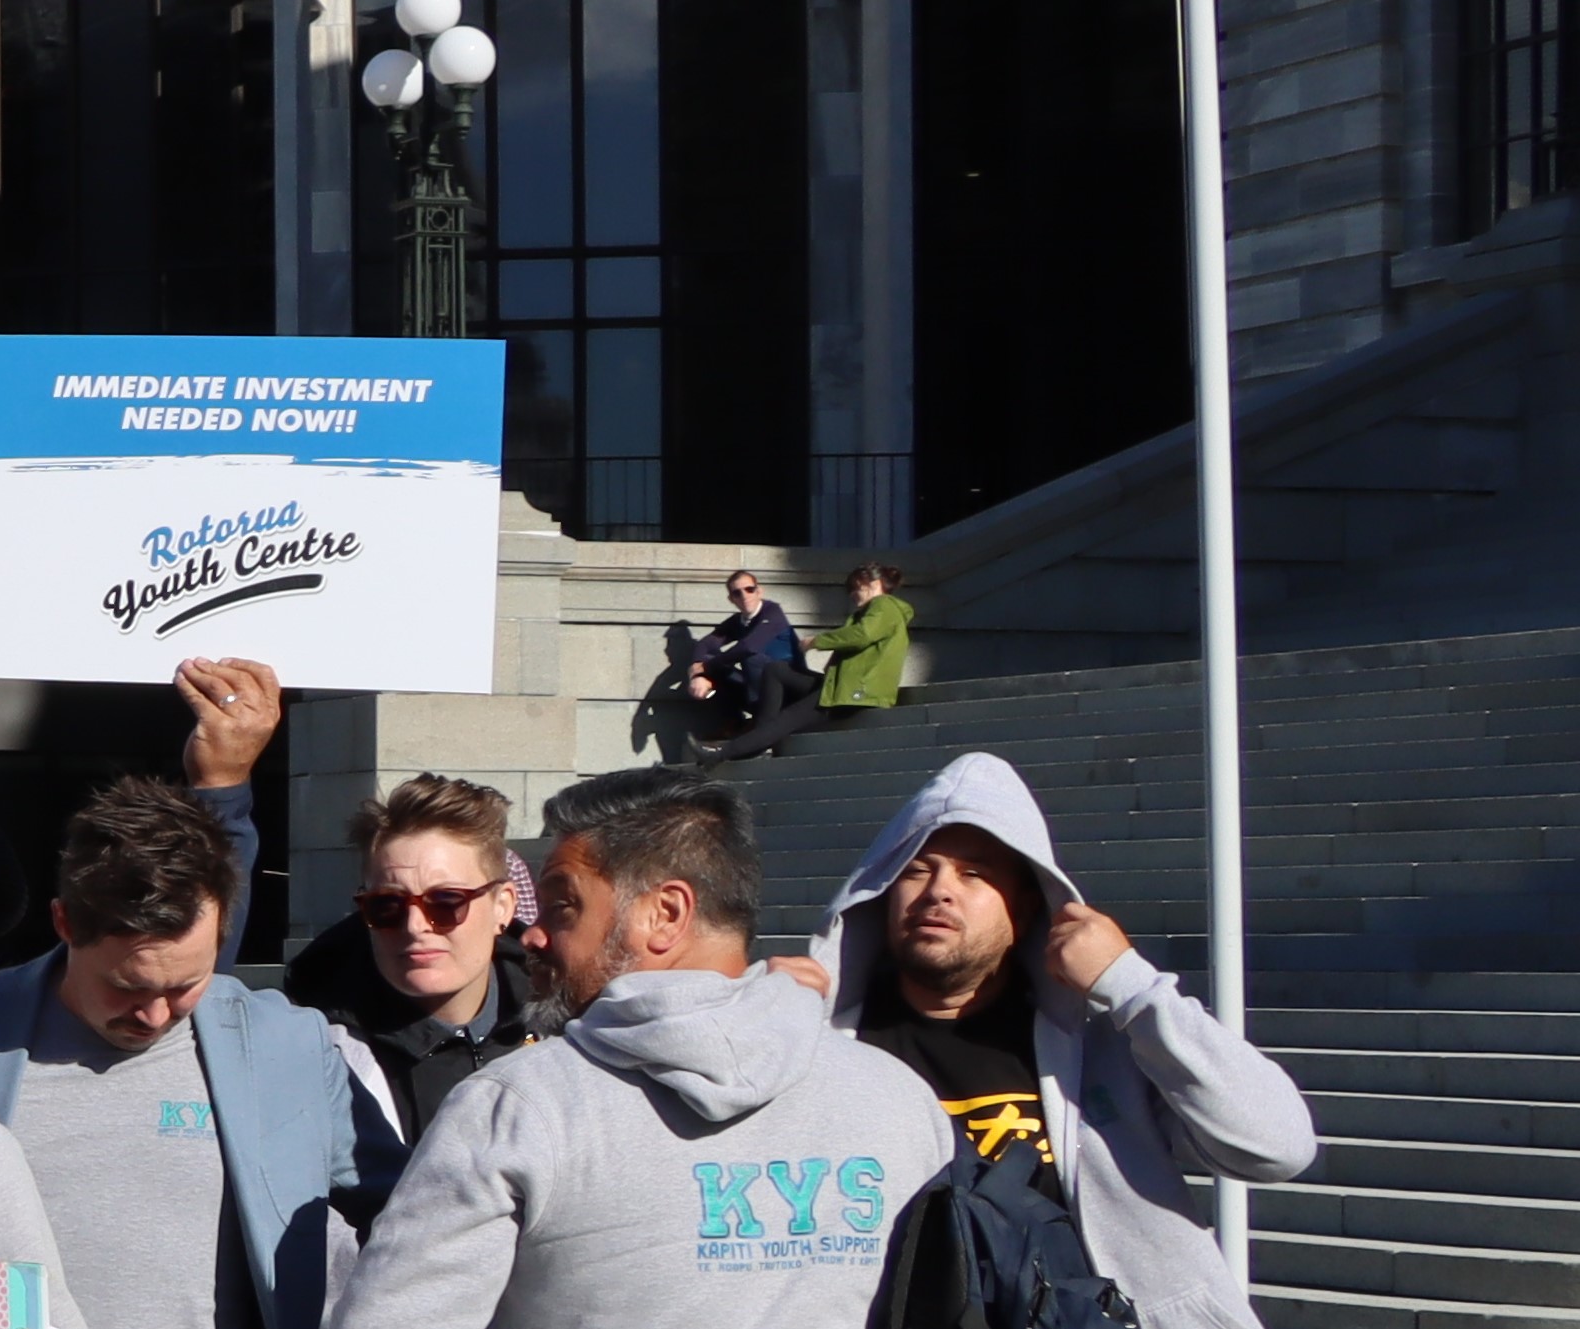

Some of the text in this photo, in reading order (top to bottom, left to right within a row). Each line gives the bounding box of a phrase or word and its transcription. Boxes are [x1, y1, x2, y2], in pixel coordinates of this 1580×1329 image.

[53, 375, 433, 403] IMMEDIATE INVESTMENT
[121, 406, 358, 434] NEEDED NOW!!
[142, 499, 305, 567] Rotorua
[103, 526, 360, 631] Youth Centre
[159, 1101, 212, 1128] KY
[693, 1156, 885, 1239] KYS
[762, 1239, 813, 1258] YOUTH
[819, 1235, 881, 1254] SUPPORT
